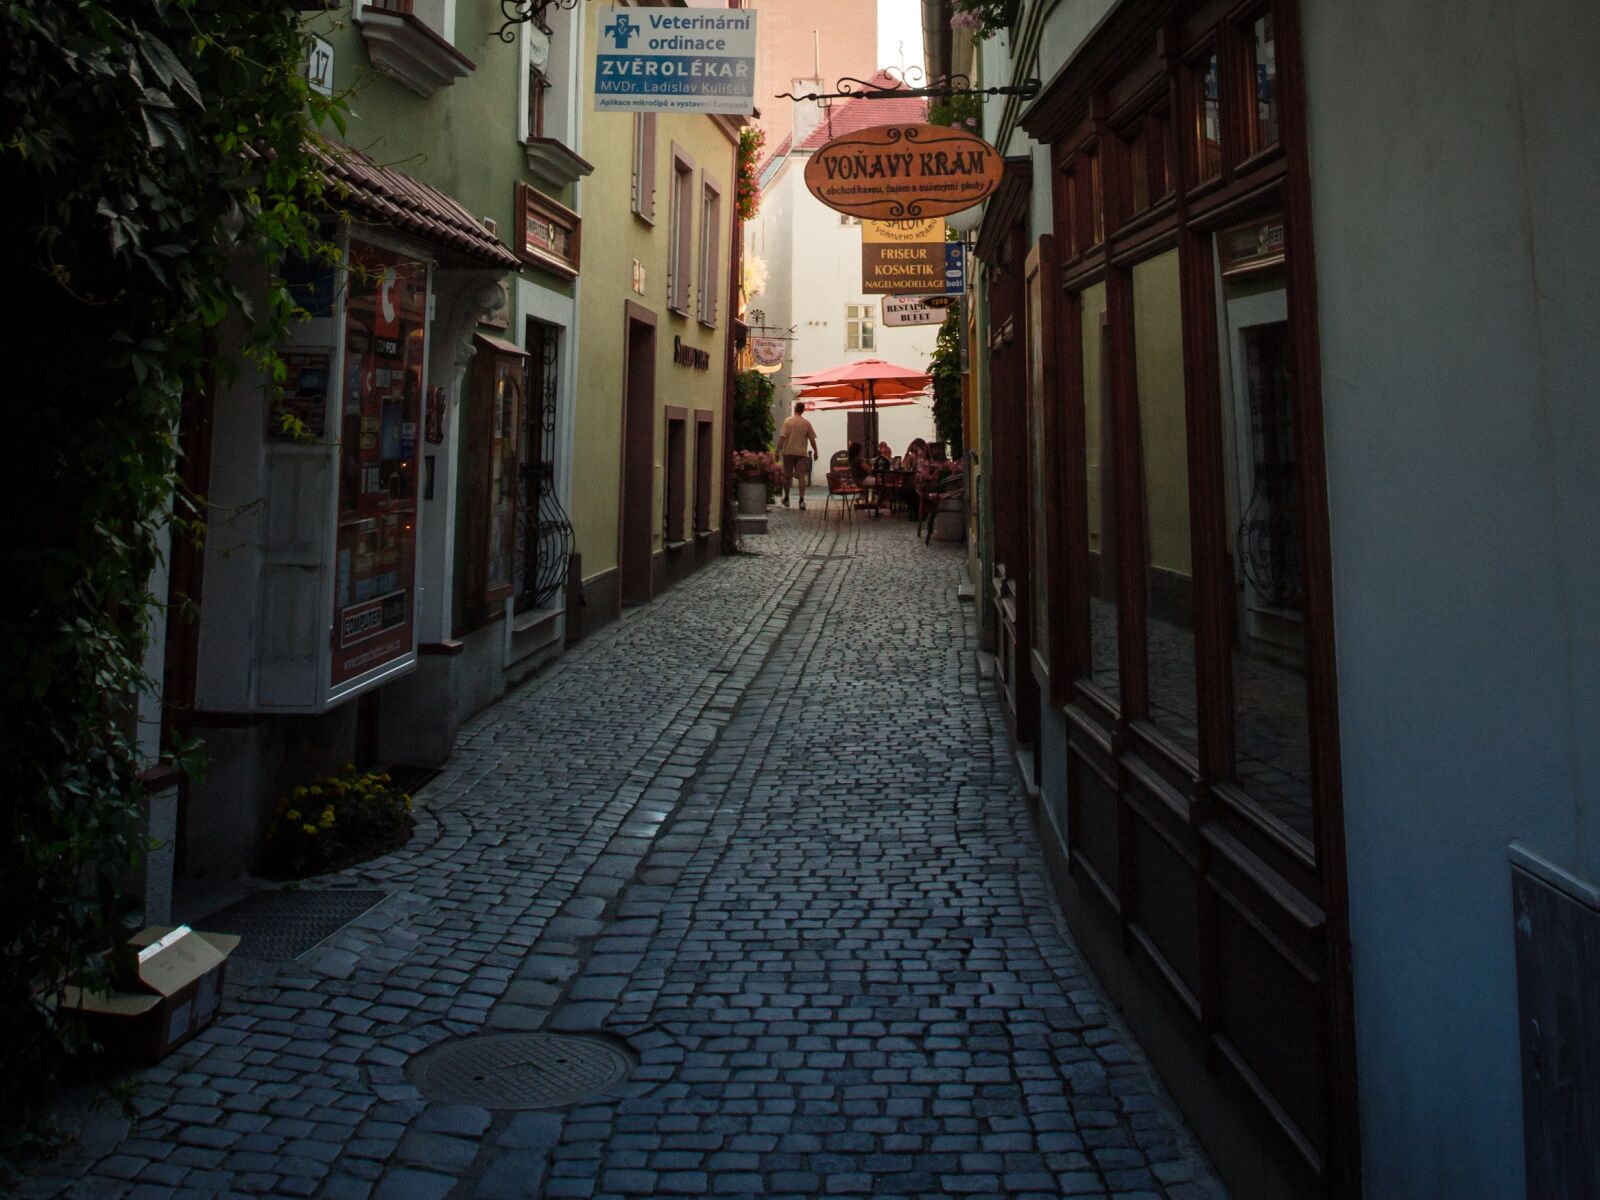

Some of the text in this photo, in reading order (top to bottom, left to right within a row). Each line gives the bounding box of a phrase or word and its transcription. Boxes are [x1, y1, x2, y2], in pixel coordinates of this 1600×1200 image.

[649, 14, 751, 30] Veterinární
[649, 35, 726, 51] ordinace
[602, 58, 749, 78] ZVĚROLÉKAŘ
[601, 81, 749, 94] MVDr. Ladislav Kulíšek
[823, 146, 985, 179] VOŇAVÝ KRÁM
[881, 248, 927, 259] FRISEUR
[874, 264, 934, 275] KOSMETIK
[865, 280, 944, 288] NAGELMODELLAGE
